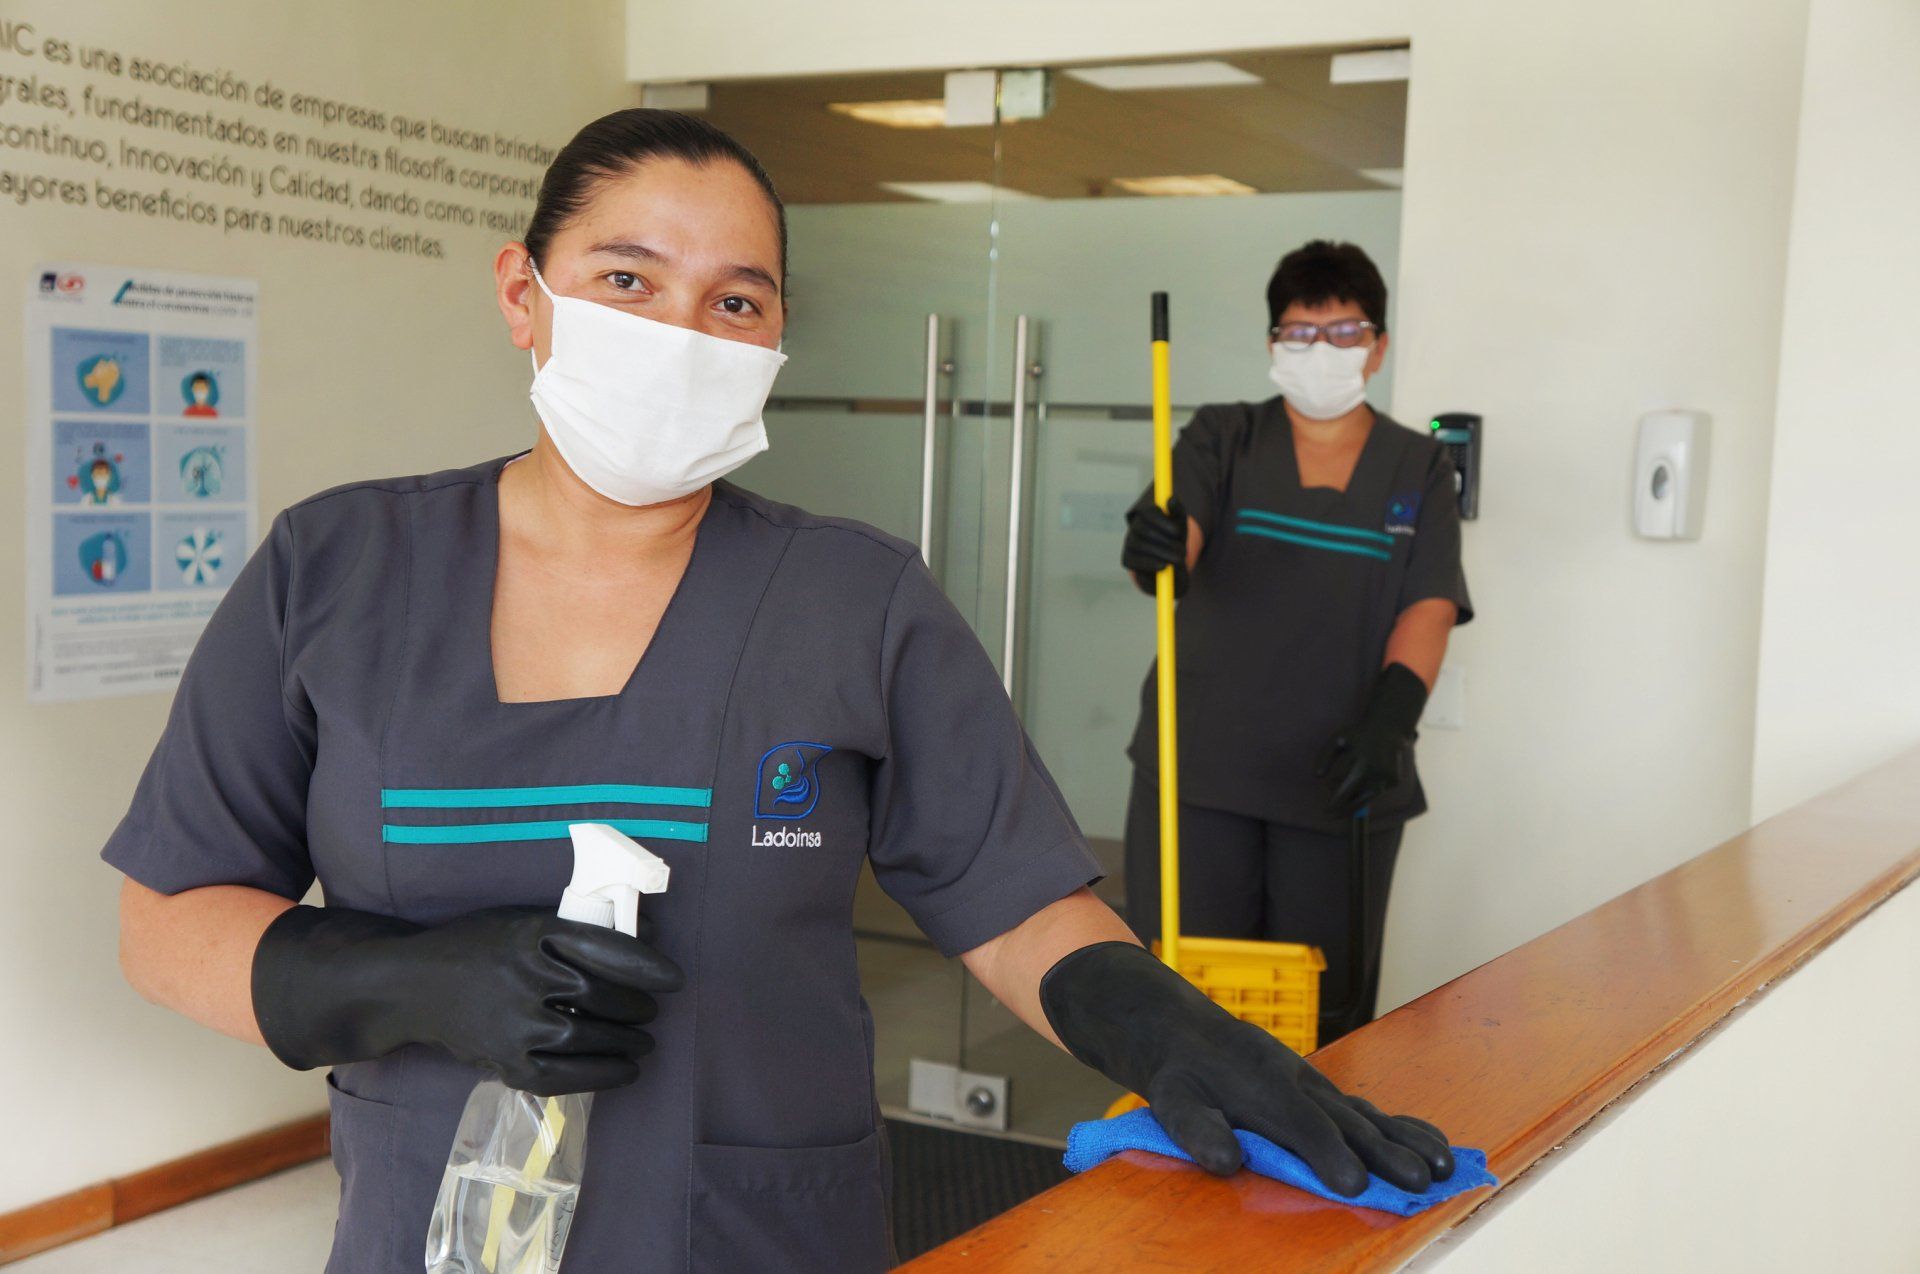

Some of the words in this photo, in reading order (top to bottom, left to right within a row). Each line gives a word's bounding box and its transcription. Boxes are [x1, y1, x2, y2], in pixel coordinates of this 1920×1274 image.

[42, 38, 73, 65] es
[79, 47, 122, 76] una
[129, 57, 248, 104] asociación
[254, 80, 285, 112] de
[290, 93, 386, 133] empresas
[391, 115, 426, 142] que
[431, 118, 490, 154] buscan
[83, 84, 267, 149] fundamentados
[273, 131, 298, 155] en
[306, 137, 379, 171] nuestra
[385, 146, 456, 186] filosofía
[95, 177, 217, 225] beneficios
[224, 206, 272, 236] para
[278, 214, 364, 248] nuestros
[369, 225, 444, 259] clientes.
[119, 137, 244, 188] Innovación
[251, 168, 263, 199] y
[269, 164, 354, 210] Calidad,
[359, 184, 419, 218] dando
[424, 199, 474, 226] como
[479, 208, 531, 235] result
[752, 825, 822, 847] Ladoinsa
